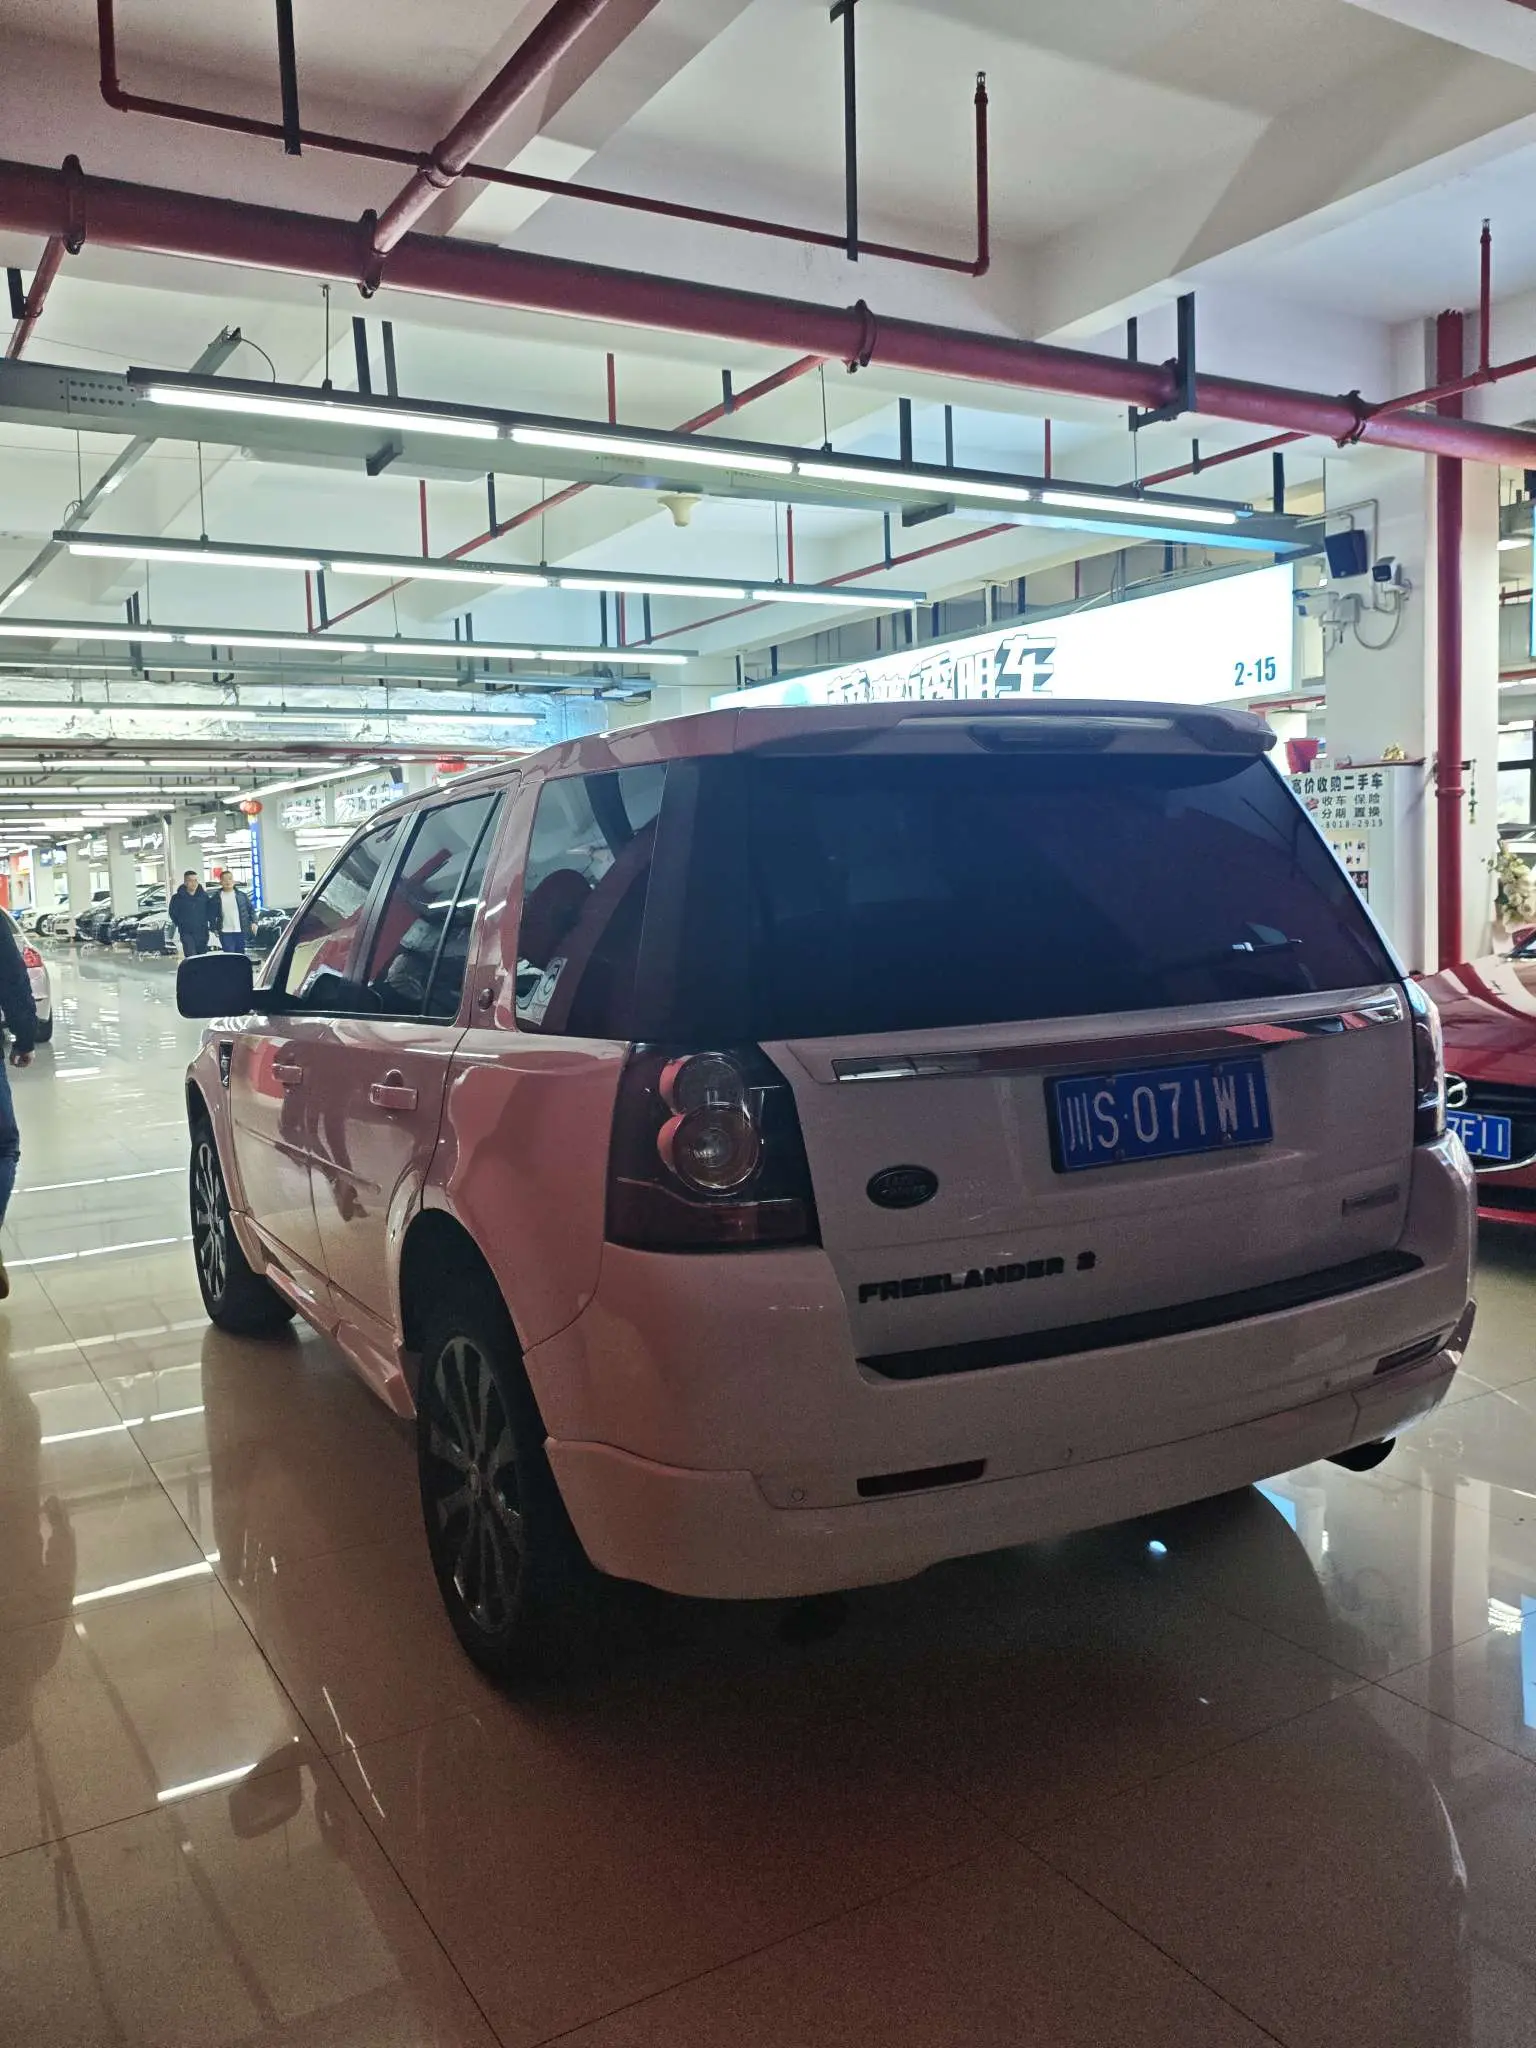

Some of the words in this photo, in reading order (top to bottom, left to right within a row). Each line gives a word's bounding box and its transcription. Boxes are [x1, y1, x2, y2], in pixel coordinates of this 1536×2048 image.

[1234, 656, 1276, 687] 2-15
[1291, 772, 1384, 796] 高价收购二手车
[857, 1256, 1065, 1304] FREELANDER
